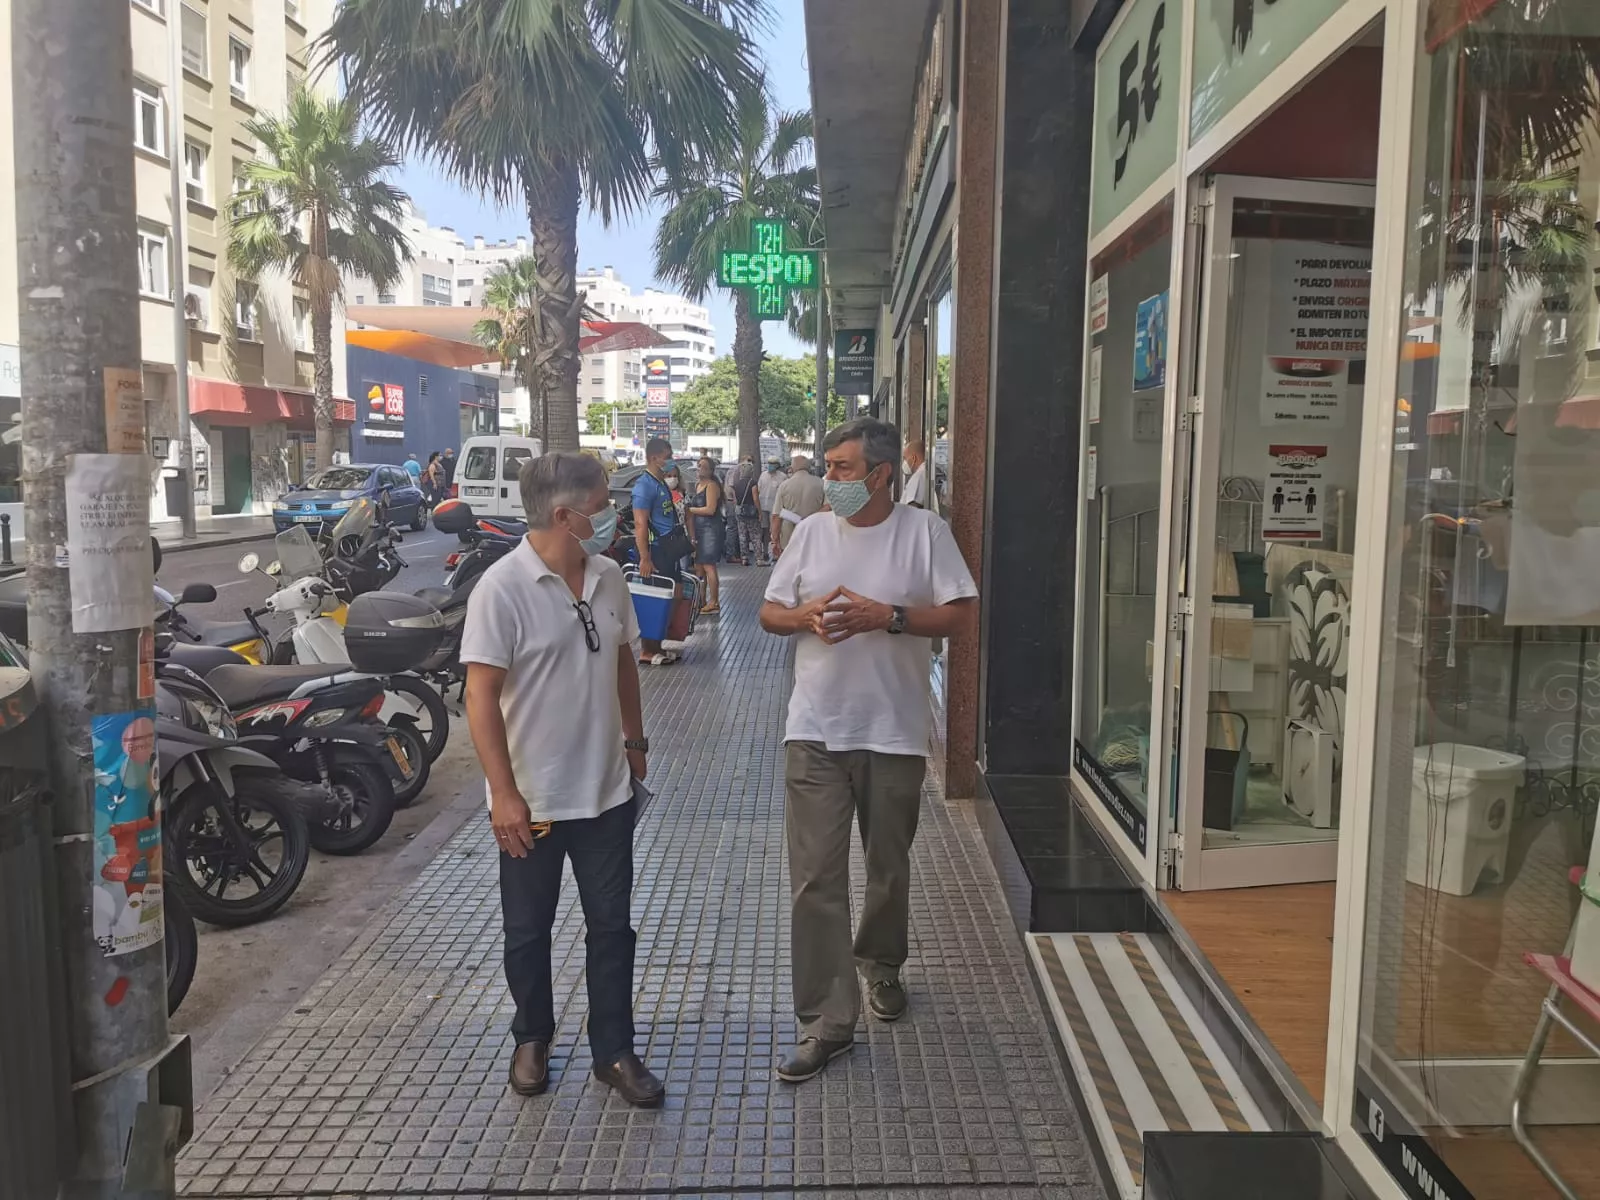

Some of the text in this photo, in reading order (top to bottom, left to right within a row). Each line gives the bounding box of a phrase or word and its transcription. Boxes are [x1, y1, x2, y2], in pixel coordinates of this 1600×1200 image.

[1113, 2, 1166, 191] 5€
[756, 224, 783, 253] 12H
[1301, 259, 1328, 270] PARA
[1300, 278, 1332, 288] PLAZO
[755, 285, 781, 314] 12H
[1298, 296, 1336, 306] ENVASE
[1297, 309, 1342, 320] ADMITEN
[1295, 328, 1308, 338] EL
[1309, 328, 1353, 339] IMPORTE
[1295, 341, 1329, 351] NUNCA
[1330, 342, 1343, 351] EN
[387, 398, 404, 414] COR
